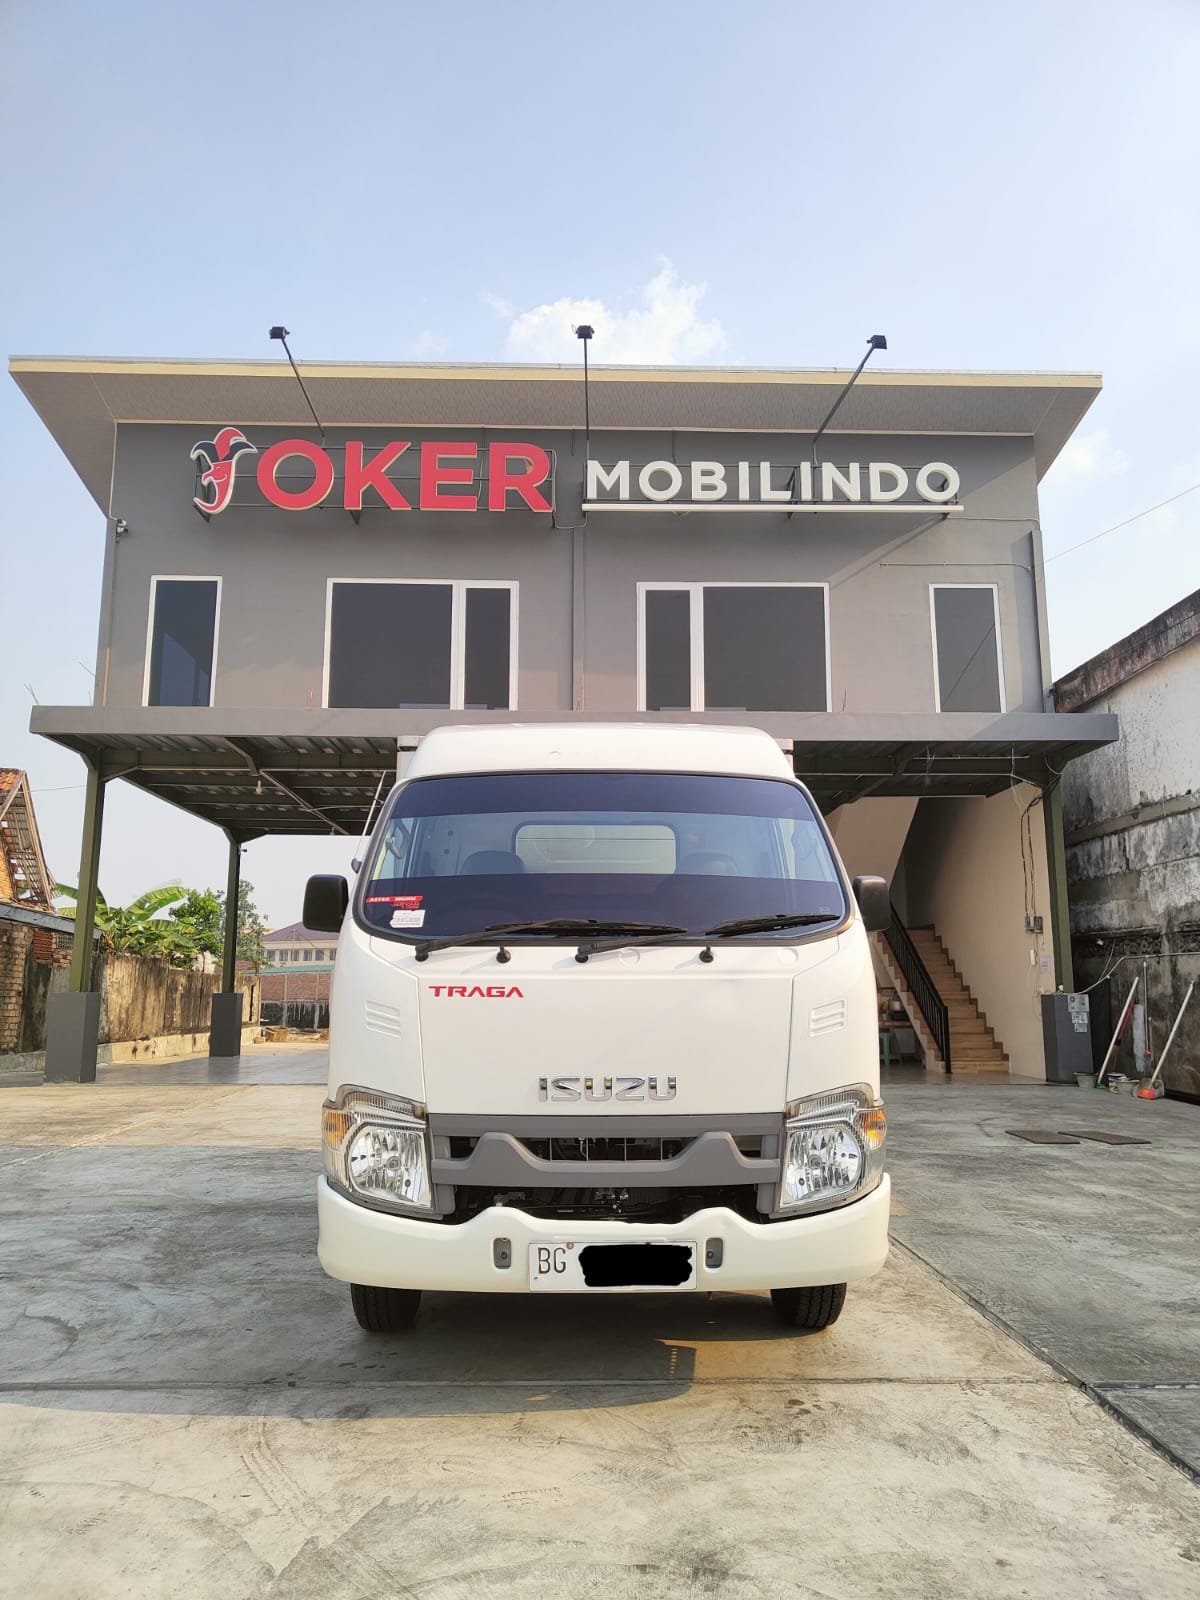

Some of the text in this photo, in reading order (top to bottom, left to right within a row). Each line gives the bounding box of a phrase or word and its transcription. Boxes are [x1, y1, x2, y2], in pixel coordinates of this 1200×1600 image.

[586, 460, 961, 503] MOBILINDO
[428, 986, 524, 998] TRAGA
[538, 1075, 677, 1102] ISUZU
[538, 1247, 567, 1274] BG
